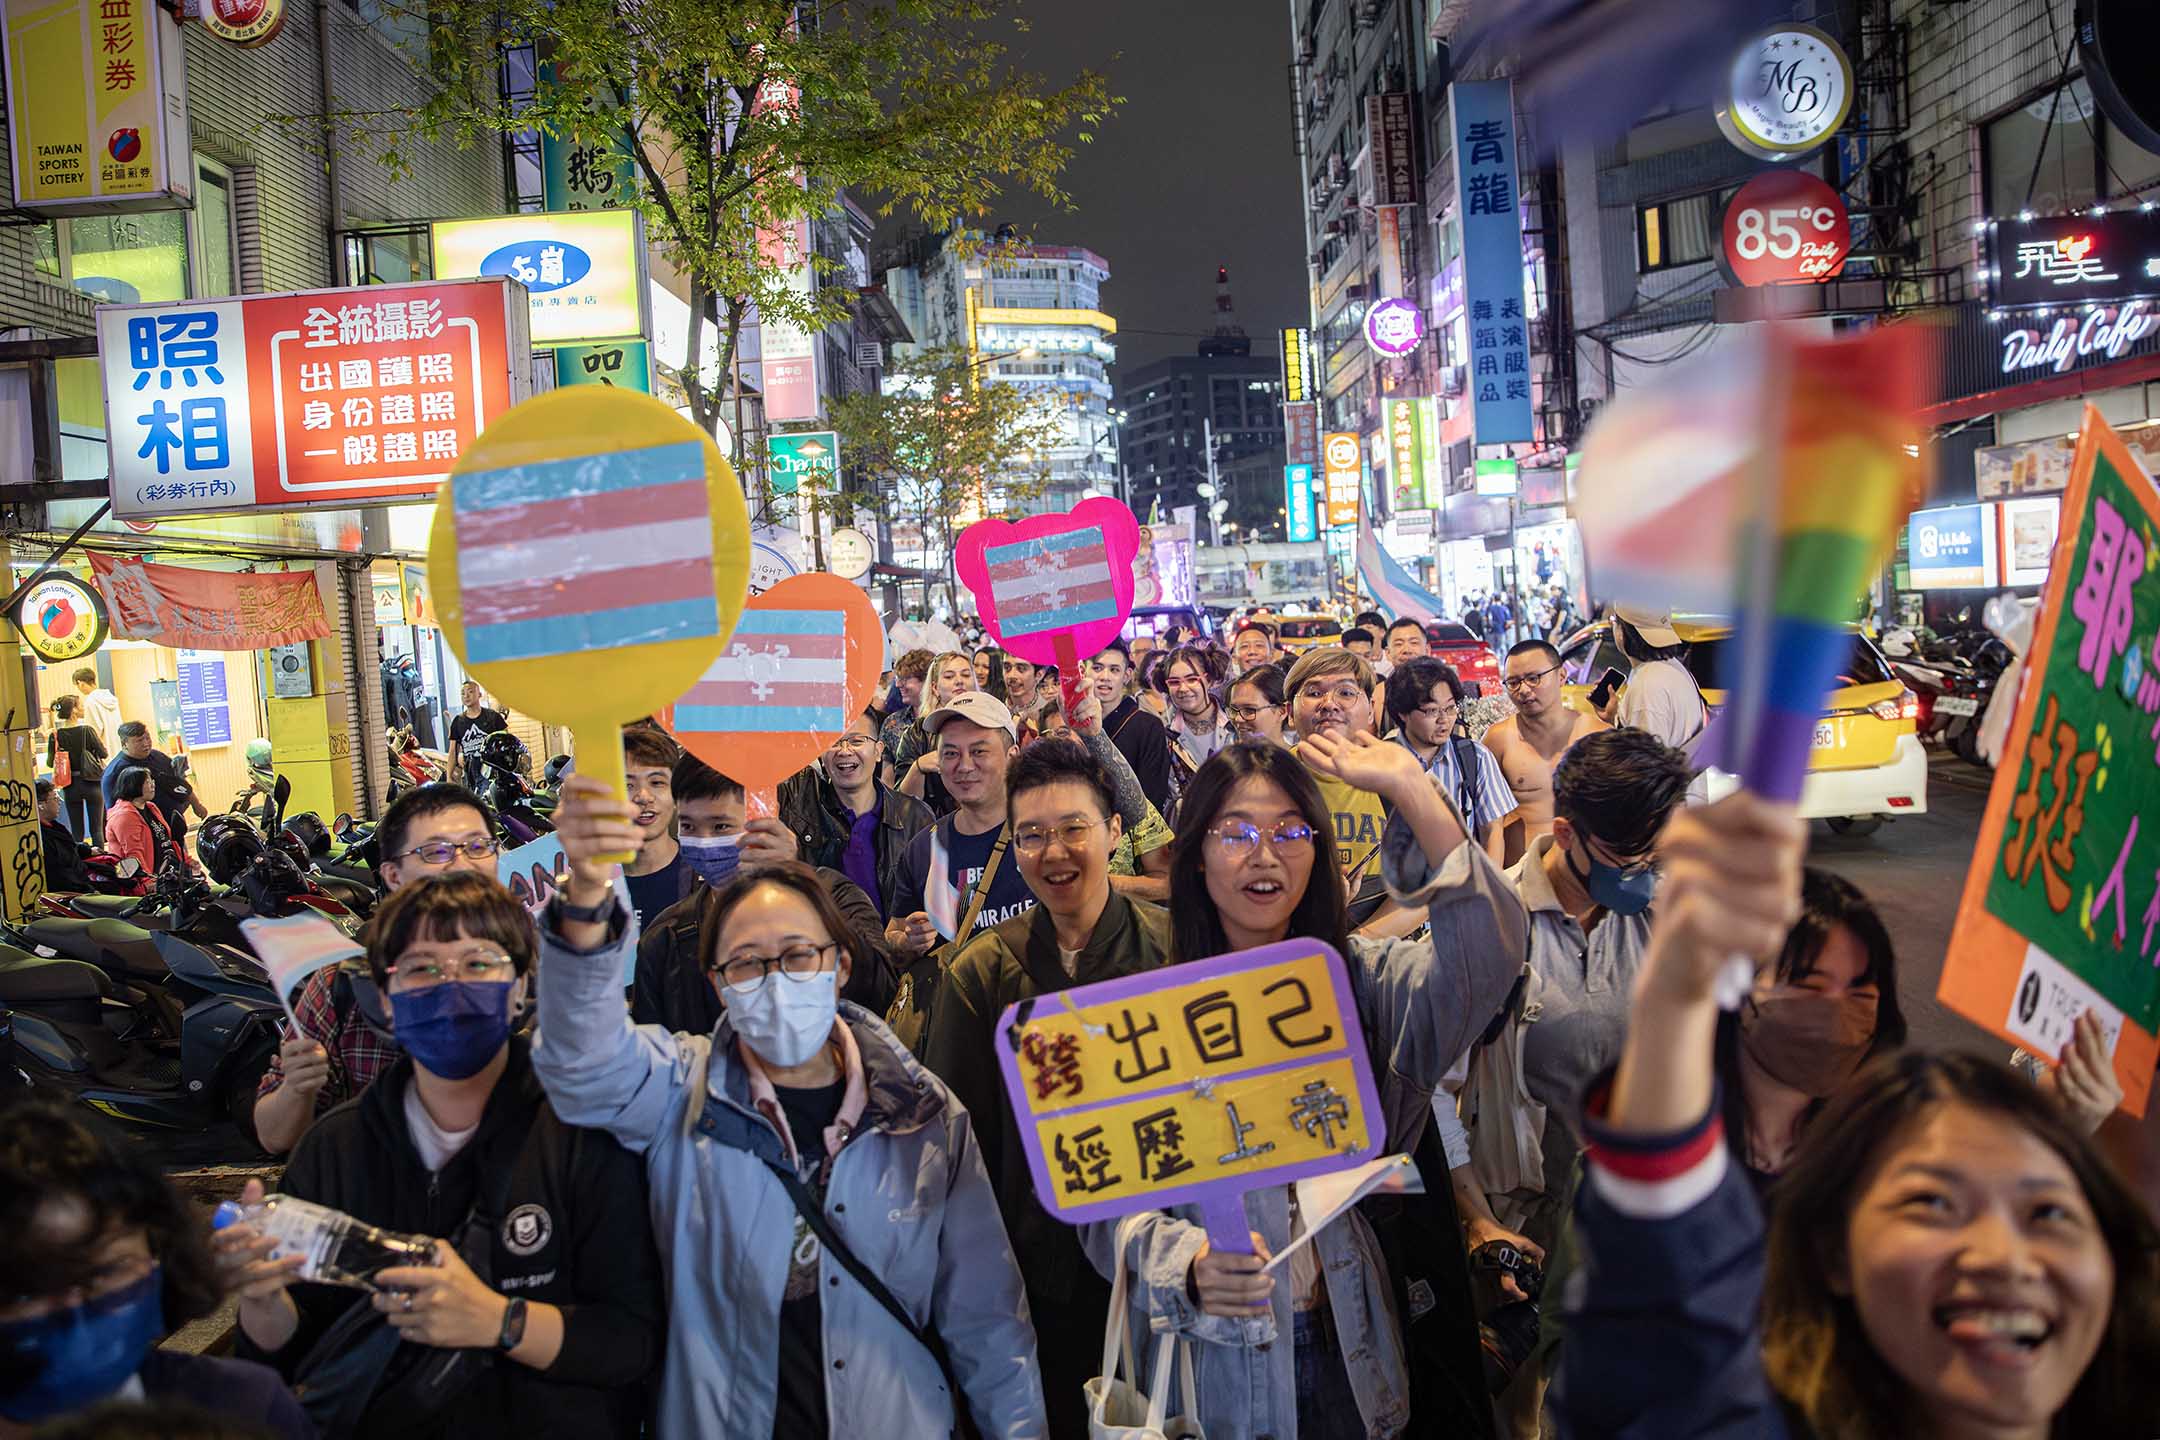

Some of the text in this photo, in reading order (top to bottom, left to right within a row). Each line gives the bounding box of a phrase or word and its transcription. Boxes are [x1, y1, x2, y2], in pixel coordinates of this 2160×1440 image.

[38, 144, 82, 157] TAIWAN
[39, 158, 80, 171] SPORTS
[1465, 120, 1512, 216] 青龍
[40, 172, 85, 185] LOTTERY
[1736, 206, 1836, 260] 85°C
[1800, 241, 1840, 260] Daily
[303, 298, 443, 349] 全統攝影
[1501, 297, 1529, 400] 表演服裝
[2002, 300, 2151, 373] Daily Cafe
[300, 352, 454, 393] 出國護照
[1473, 299, 1501, 402] 舞蹈用品
[128, 311, 230, 475] 照相
[303, 390, 457, 431] 身份證照
[303, 428, 460, 467] 一般證照
[136, 478, 236, 505] (彩券行內)
[1021, 977, 1333, 1100] 跨出自己
[1054, 1079, 1349, 1194] 經歷上帝
